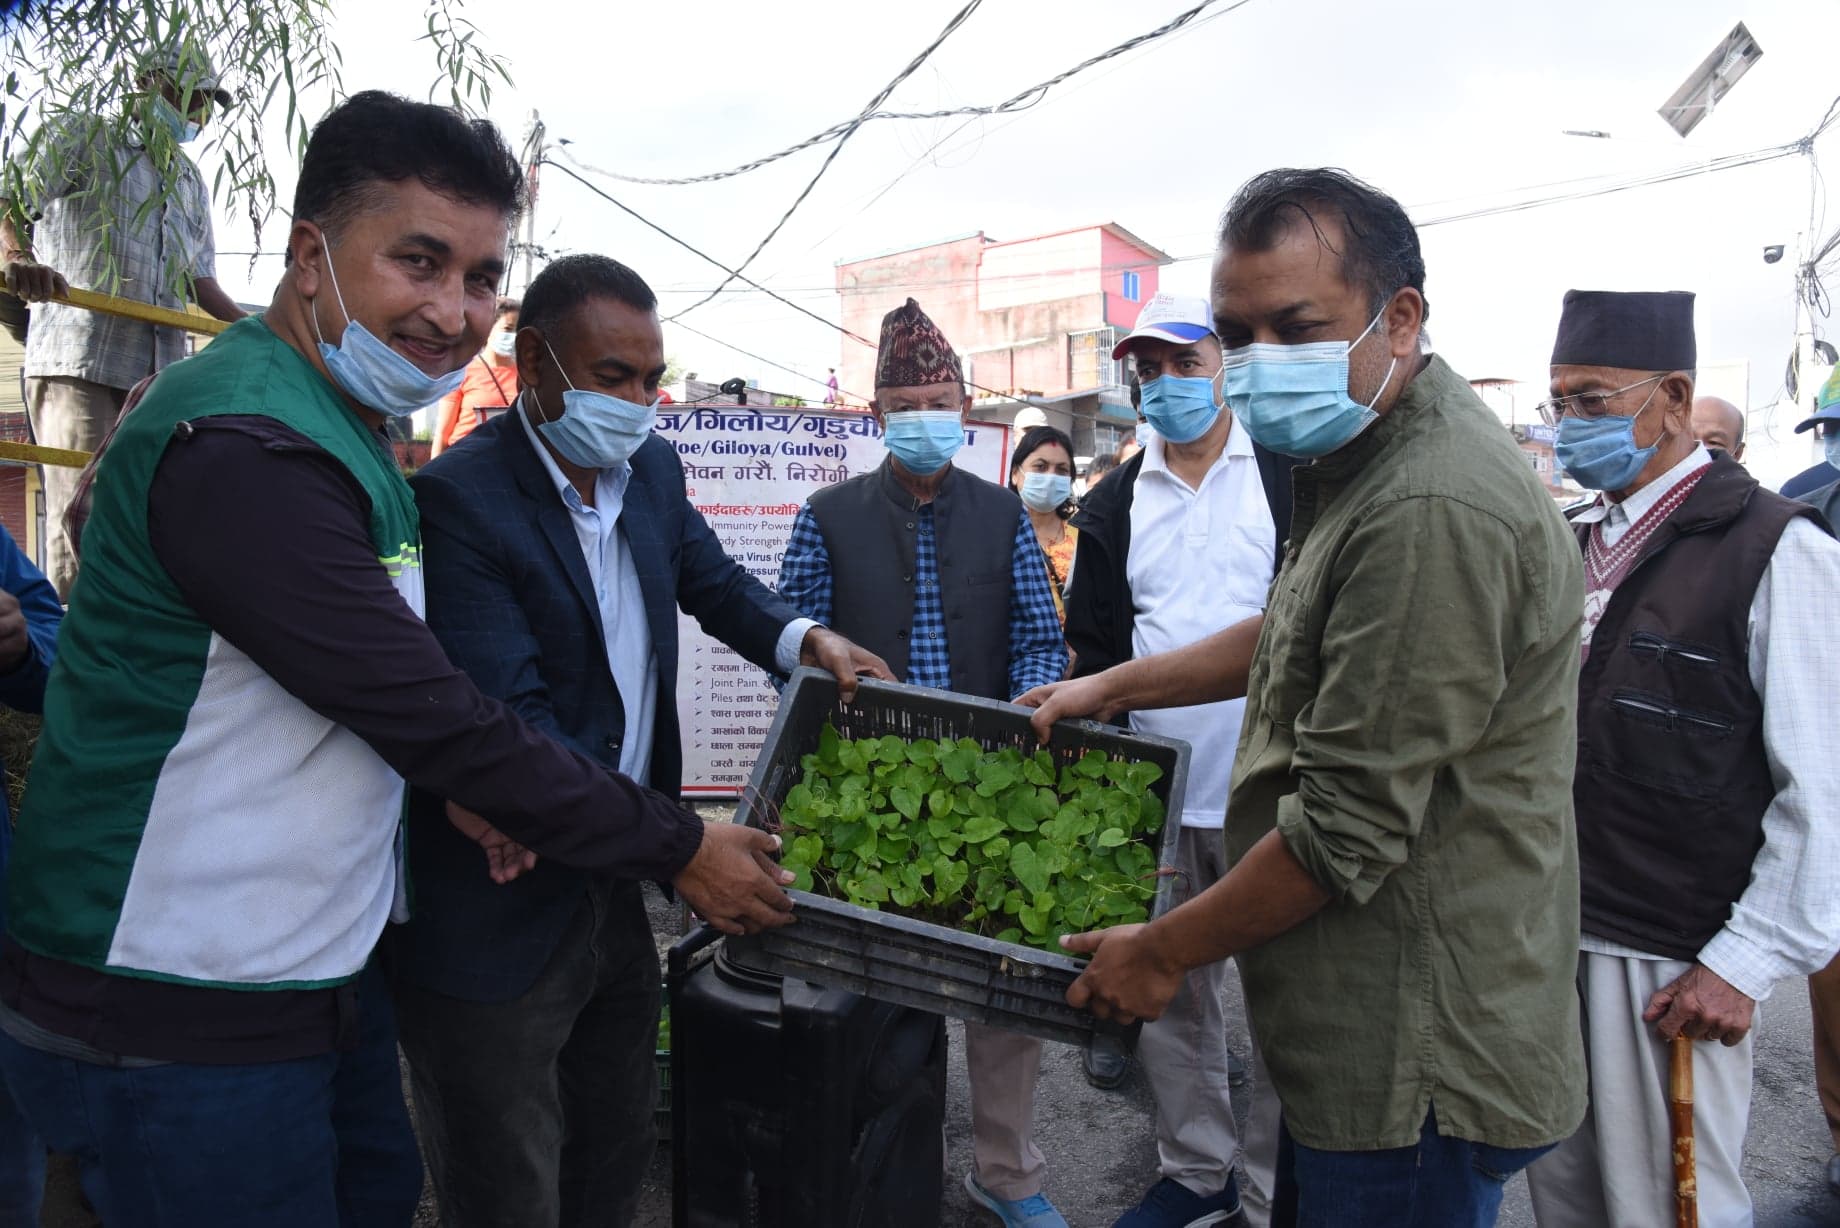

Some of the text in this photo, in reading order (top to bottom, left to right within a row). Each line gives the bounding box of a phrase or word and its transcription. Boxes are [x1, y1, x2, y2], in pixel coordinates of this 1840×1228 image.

[711, 520, 758, 532] Immunity
[739, 536, 782, 549] Strength
[747, 552, 772, 561] Virus
[711, 678, 734, 690] Joint
[711, 692, 733, 703] Piles
